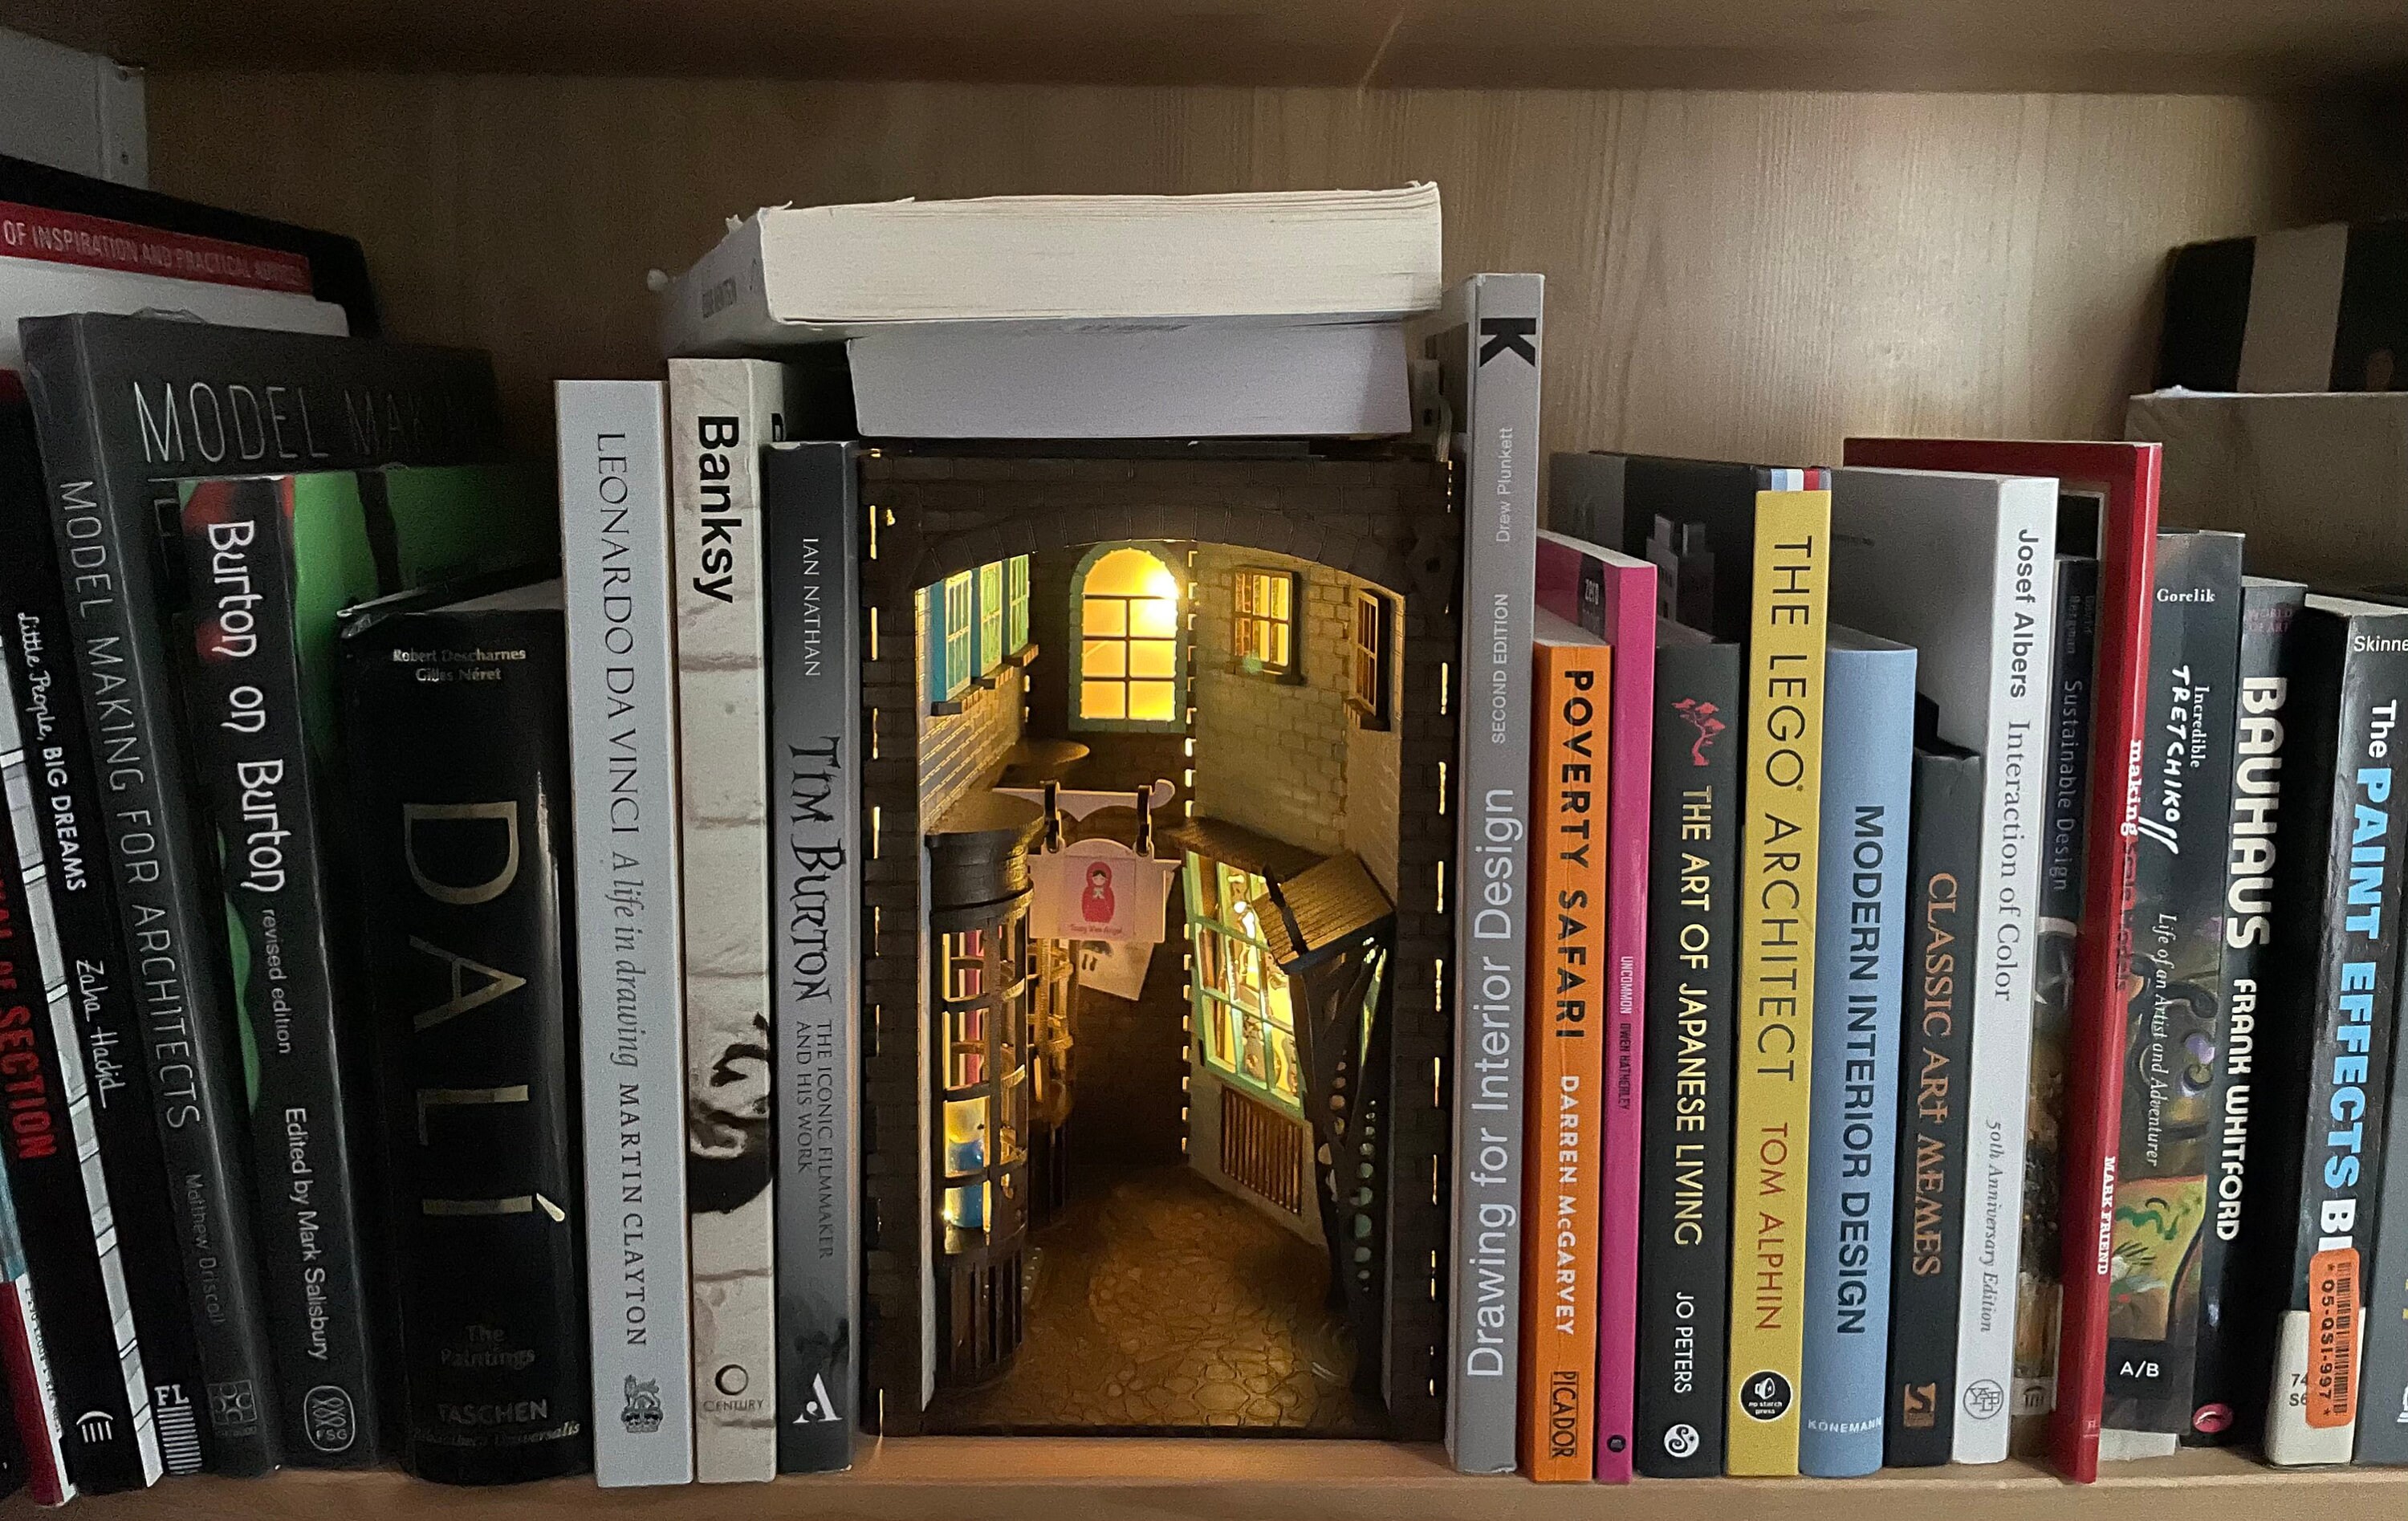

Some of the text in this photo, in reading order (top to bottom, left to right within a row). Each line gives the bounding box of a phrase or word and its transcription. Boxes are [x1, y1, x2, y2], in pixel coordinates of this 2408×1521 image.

[2, 219, 26, 246] OF
[32, 226, 138, 262] INSPIRATION
[134, 381, 329, 463] MODEL
[1495, 426, 1514, 543] Drew Plunkett
[693, 416, 742, 604] Banksy
[1771, 535, 1812, 625] THE
[18, 612, 41, 669] Little
[393, 648, 527, 663] Robert Descharnes
[803, 538, 821, 677] IAN NATHAN
[2010, 529, 2039, 698] Josef Albers
[2156, 588, 2215, 603] Gorelik
[208, 520, 292, 893] Burton on Burton
[416, 669, 454, 682] Gilles
[1492, 593, 1509, 745] SECOND EDITION
[2190, 685, 2210, 768] Incredible
[2368, 699, 2396, 758] The
[43, 746, 67, 787] BIG
[59, 482, 200, 1128] MODEL MAKING FOR ARCHITECTS
[2048, 679, 2082, 891] Sustainable Design
[2121, 739, 2143, 837] making
[51, 794, 86, 892] DREAMS
[597, 433, 646, 1346] LEONARDO DA VINCI A life in drawing MARTIN CLAYTON
[788, 736, 846, 1002] TIM BURTON
[1556, 671, 1594, 1038] POVERTY SAFARI
[1994, 721, 2031, 1002] Interaction of Color
[2345, 768, 2392, 940] PAINT
[262, 909, 292, 1055] revised edition
[1620, 956, 1634, 1015] UNCOMMON
[1674, 785, 1712, 1246] THE ART OF JAPANESE LIVING
[1757, 812, 1803, 1081] ARCHITECT
[2216, 677, 2288, 1241] BAUHAUS FRANK WHITFORD
[0, 1005, 57, 1159] SECTION
[75, 959, 126, 1109] Zaha Hadid
[796, 1022, 813, 1173] AND HIS WORK
[1467, 789, 1523, 1377] Drawing for Interior Design
[1617, 1023, 1632, 1111] OWEN HATHERLEY
[1837, 805, 1885, 1334] MODERN INTERIOR DESIGN
[1912, 872, 1958, 1276] CLASSIC ART MEMES
[2145, 913, 2178, 1167] Life of an Artist and Adventurer
[2325, 962, 2377, 1190] EFFECTS
[816, 1019, 833, 1259] THE ICONIC FILMMAKER
[1556, 1076, 1580, 1336] DARREN McGARVEY
[1760, 1122, 1788, 1196] TOM
[185, 1174, 226, 1324] Matthew Driscoll
[285, 1108, 330, 1362] Edited by Mark Salisbury
[1755, 1212, 1784, 1330] ALPHIN
[1979, 1119, 2004, 1332] 50th Anniversary Edition
[2097, 1156, 2116, 1275] MARK FRIEND
[441, 1348, 535, 1370] Paintings
[467, 1325, 505, 1343] The
[703, 1399, 765, 1412] CENTURY
[1674, 1291, 1694, 1393] JO PETERS
[1748, 1400, 1762, 1408] no
[2120, 1360, 2160, 1378] A/B
[437, 1398, 547, 1425] TASCHEN
[1552, 1371, 1578, 1459] PICADOR
